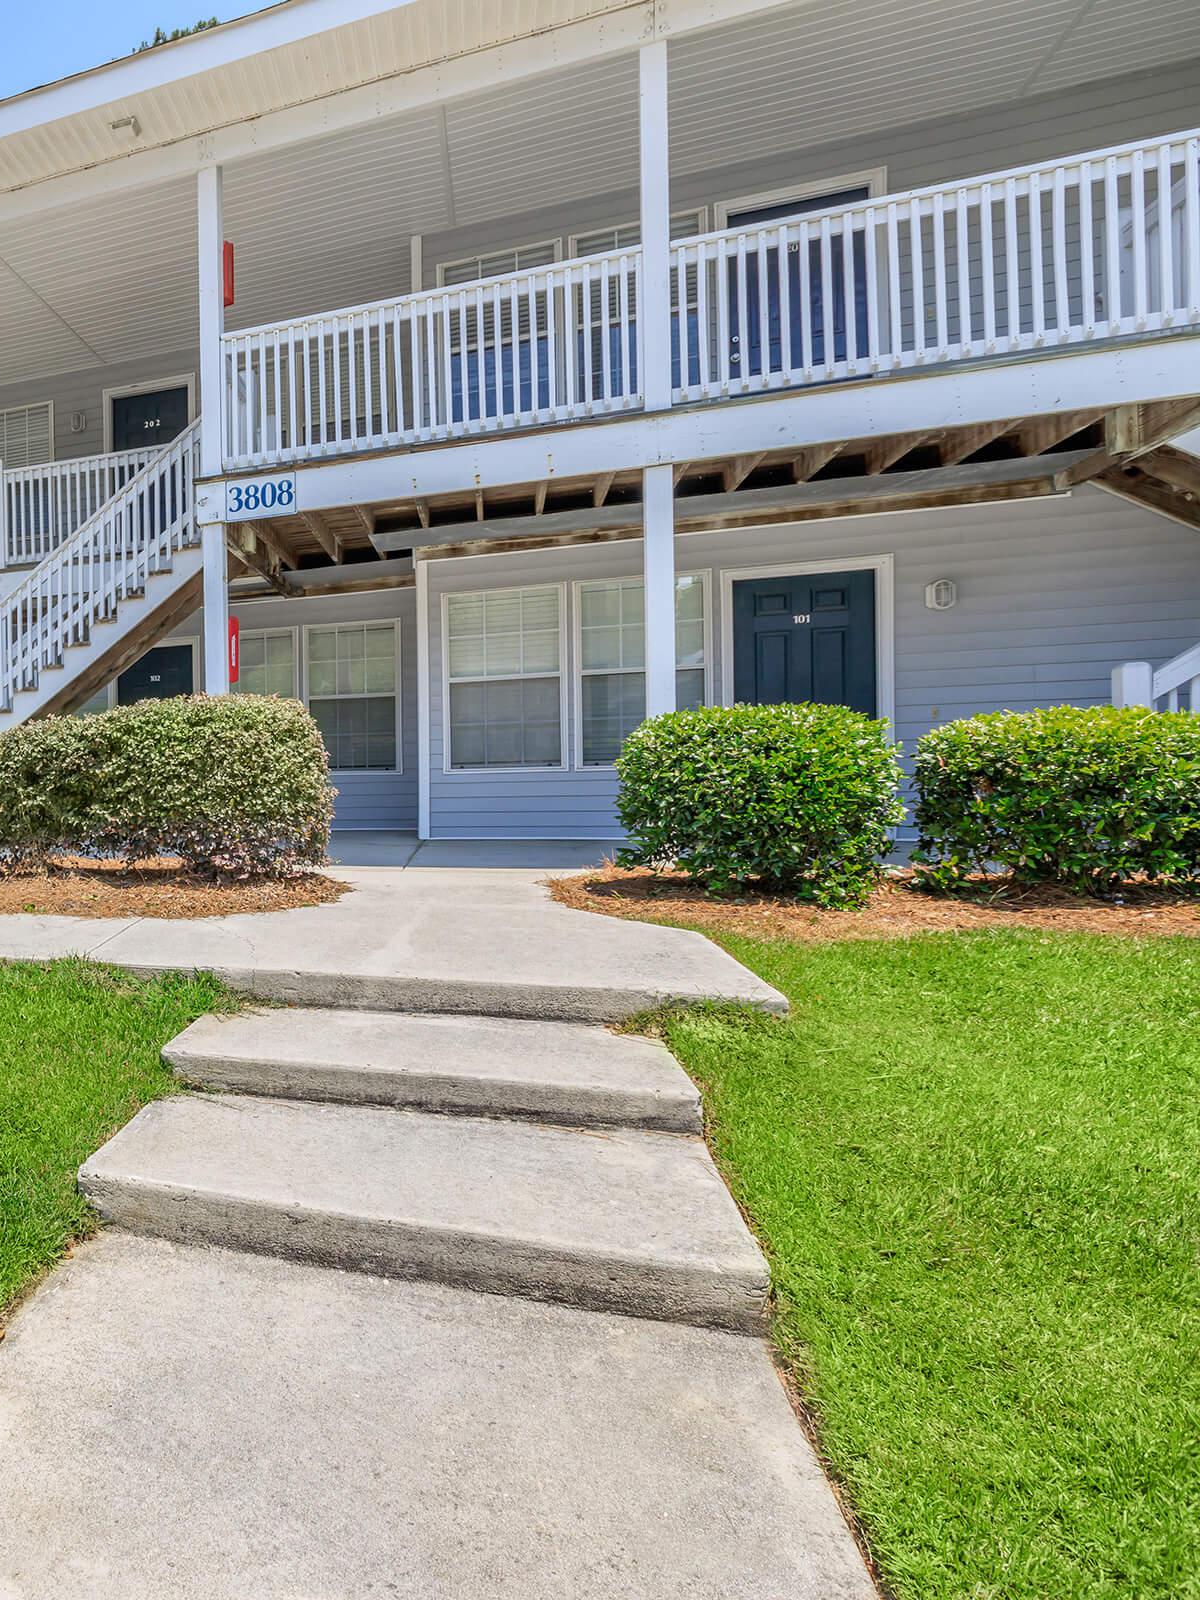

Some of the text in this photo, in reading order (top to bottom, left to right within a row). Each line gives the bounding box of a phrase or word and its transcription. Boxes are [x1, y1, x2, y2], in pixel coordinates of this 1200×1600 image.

[144, 419, 160, 428] 202
[229, 480, 293, 512] 3808
[793, 614, 810, 624] 101
